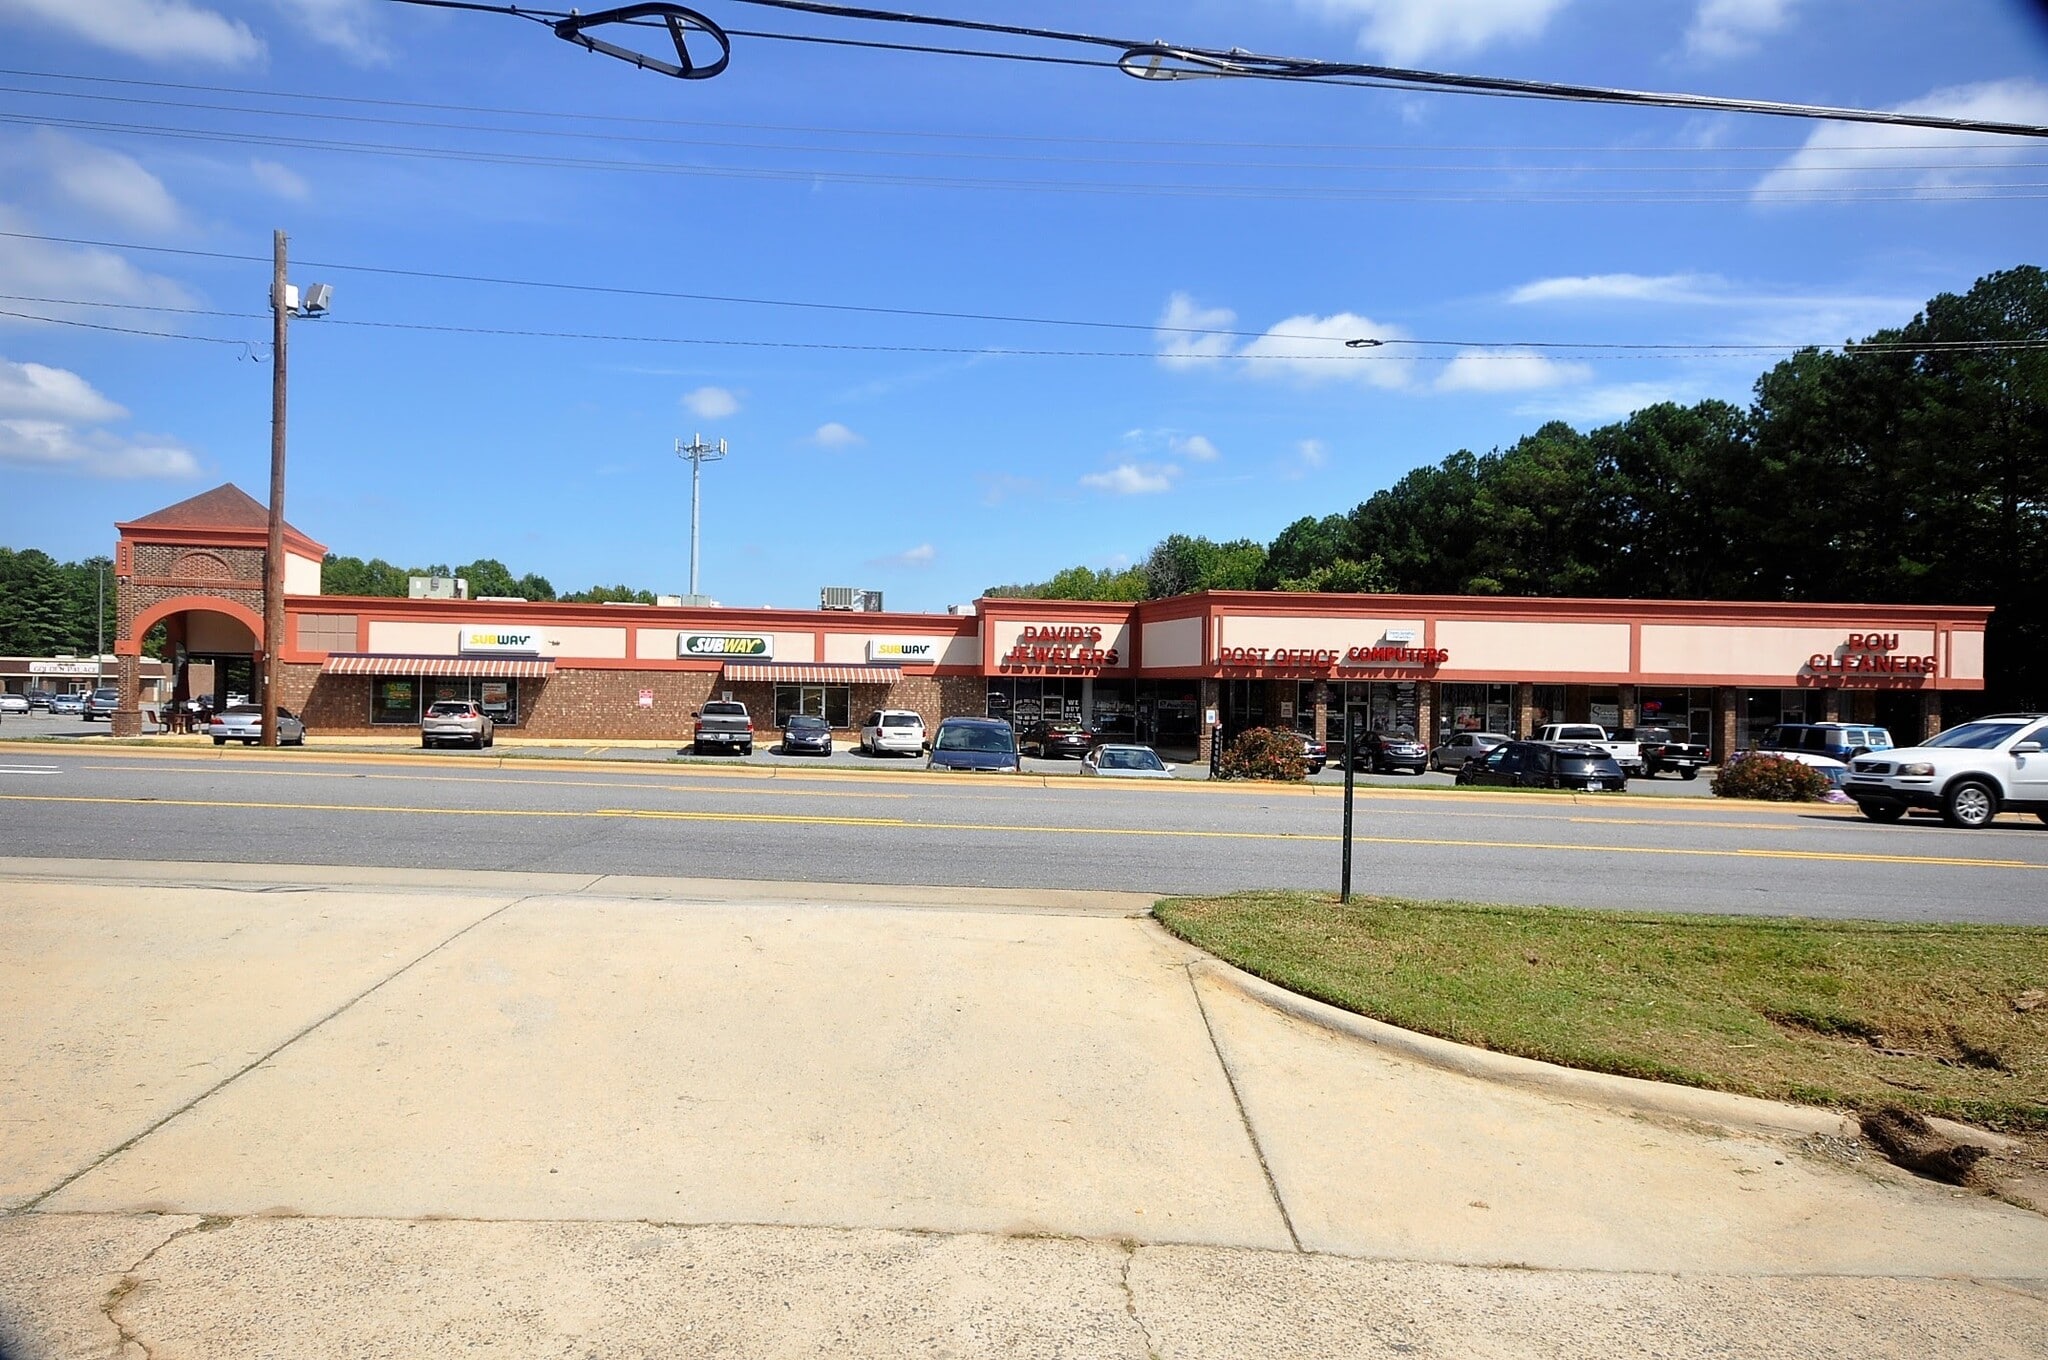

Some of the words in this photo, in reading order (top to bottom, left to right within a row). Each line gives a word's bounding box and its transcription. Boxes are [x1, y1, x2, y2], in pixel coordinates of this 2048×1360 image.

[469, 634, 531, 646] SUBWAY
[1024, 626, 1102, 642] DAVID'S
[691, 637, 762, 653] SUBWAY
[878, 644, 931, 654] SUBWAY
[1005, 646, 1119, 665] JEWELERS
[1220, 647, 1269, 666] POST
[1274, 648, 1340, 668] OFFICE
[1348, 646, 1449, 663] COMPUTERS
[1809, 654, 1938, 674] CLEANERS
